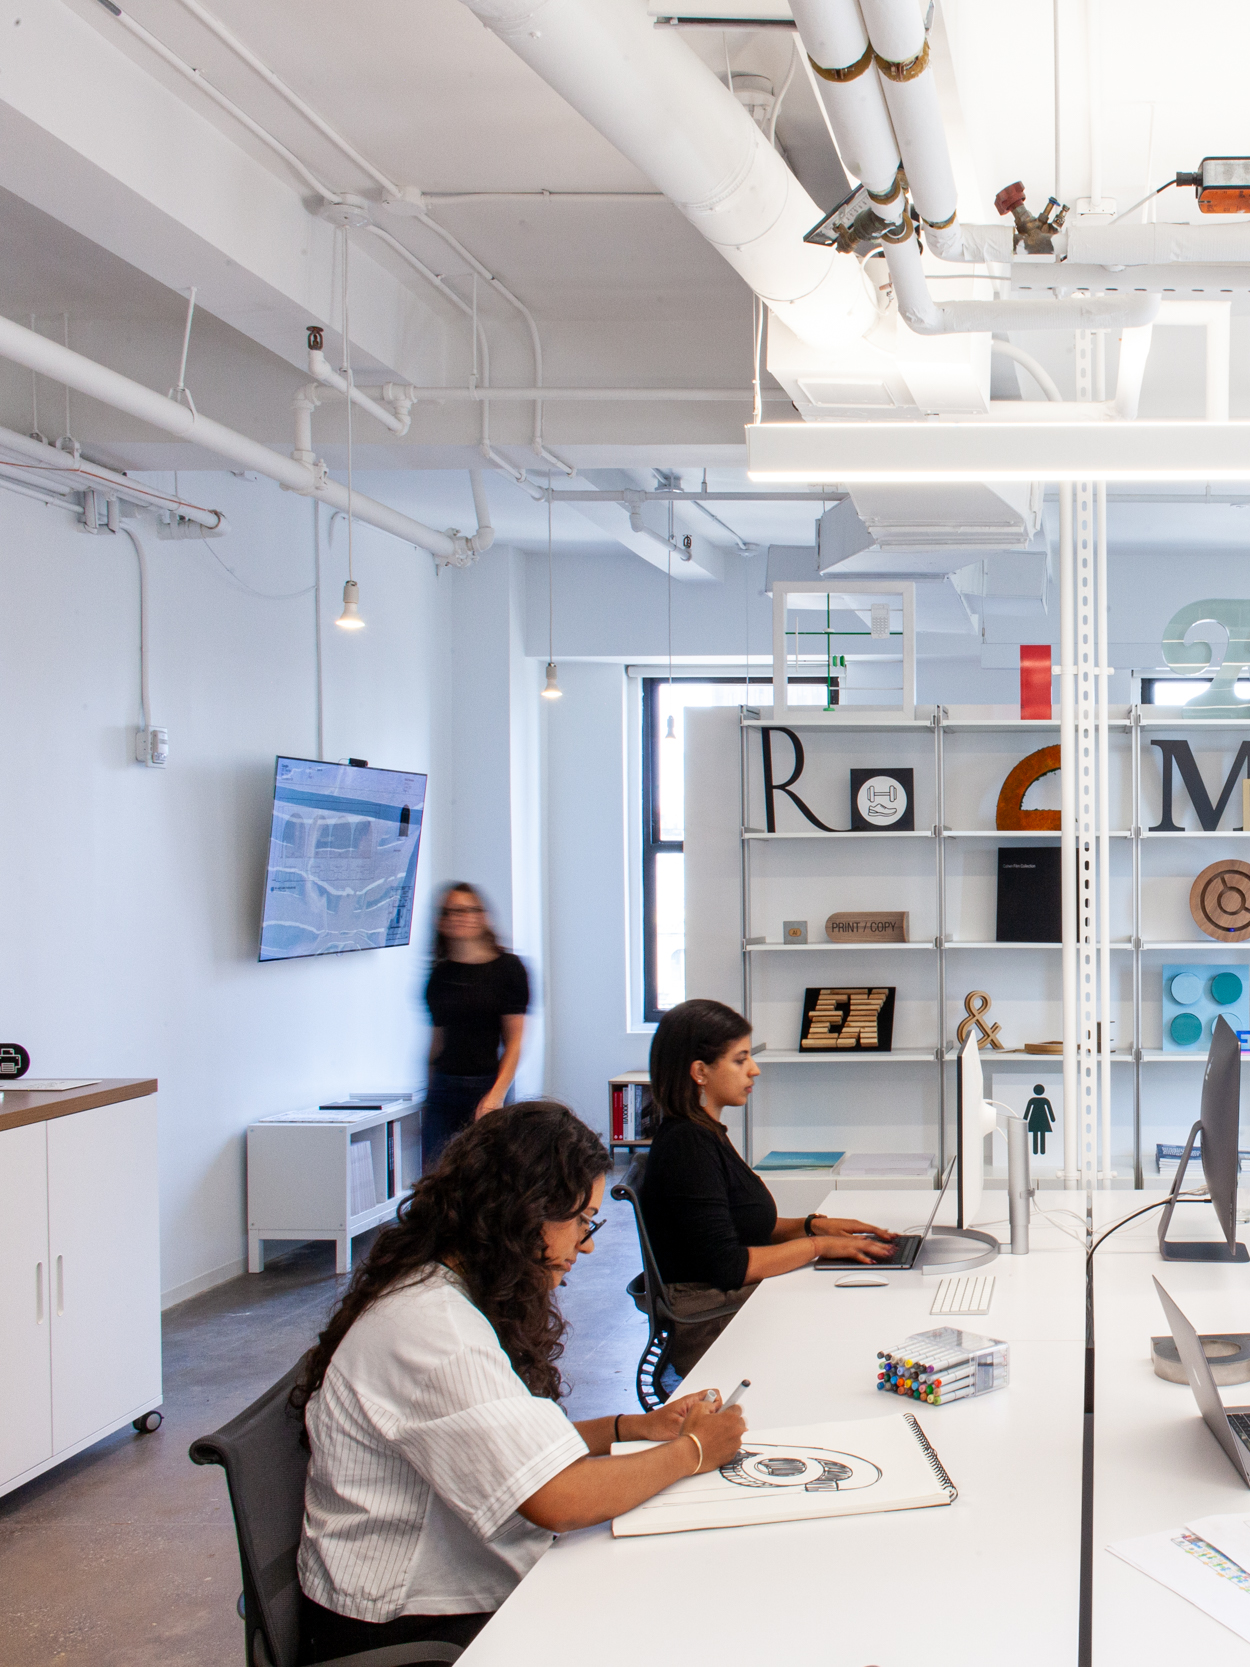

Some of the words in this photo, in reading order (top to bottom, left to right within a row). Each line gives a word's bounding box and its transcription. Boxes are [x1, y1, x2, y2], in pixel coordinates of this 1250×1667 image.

[761, 727, 858, 832] R
[831, 922, 860, 932] PRINT
[869, 922, 897, 932] COPY
